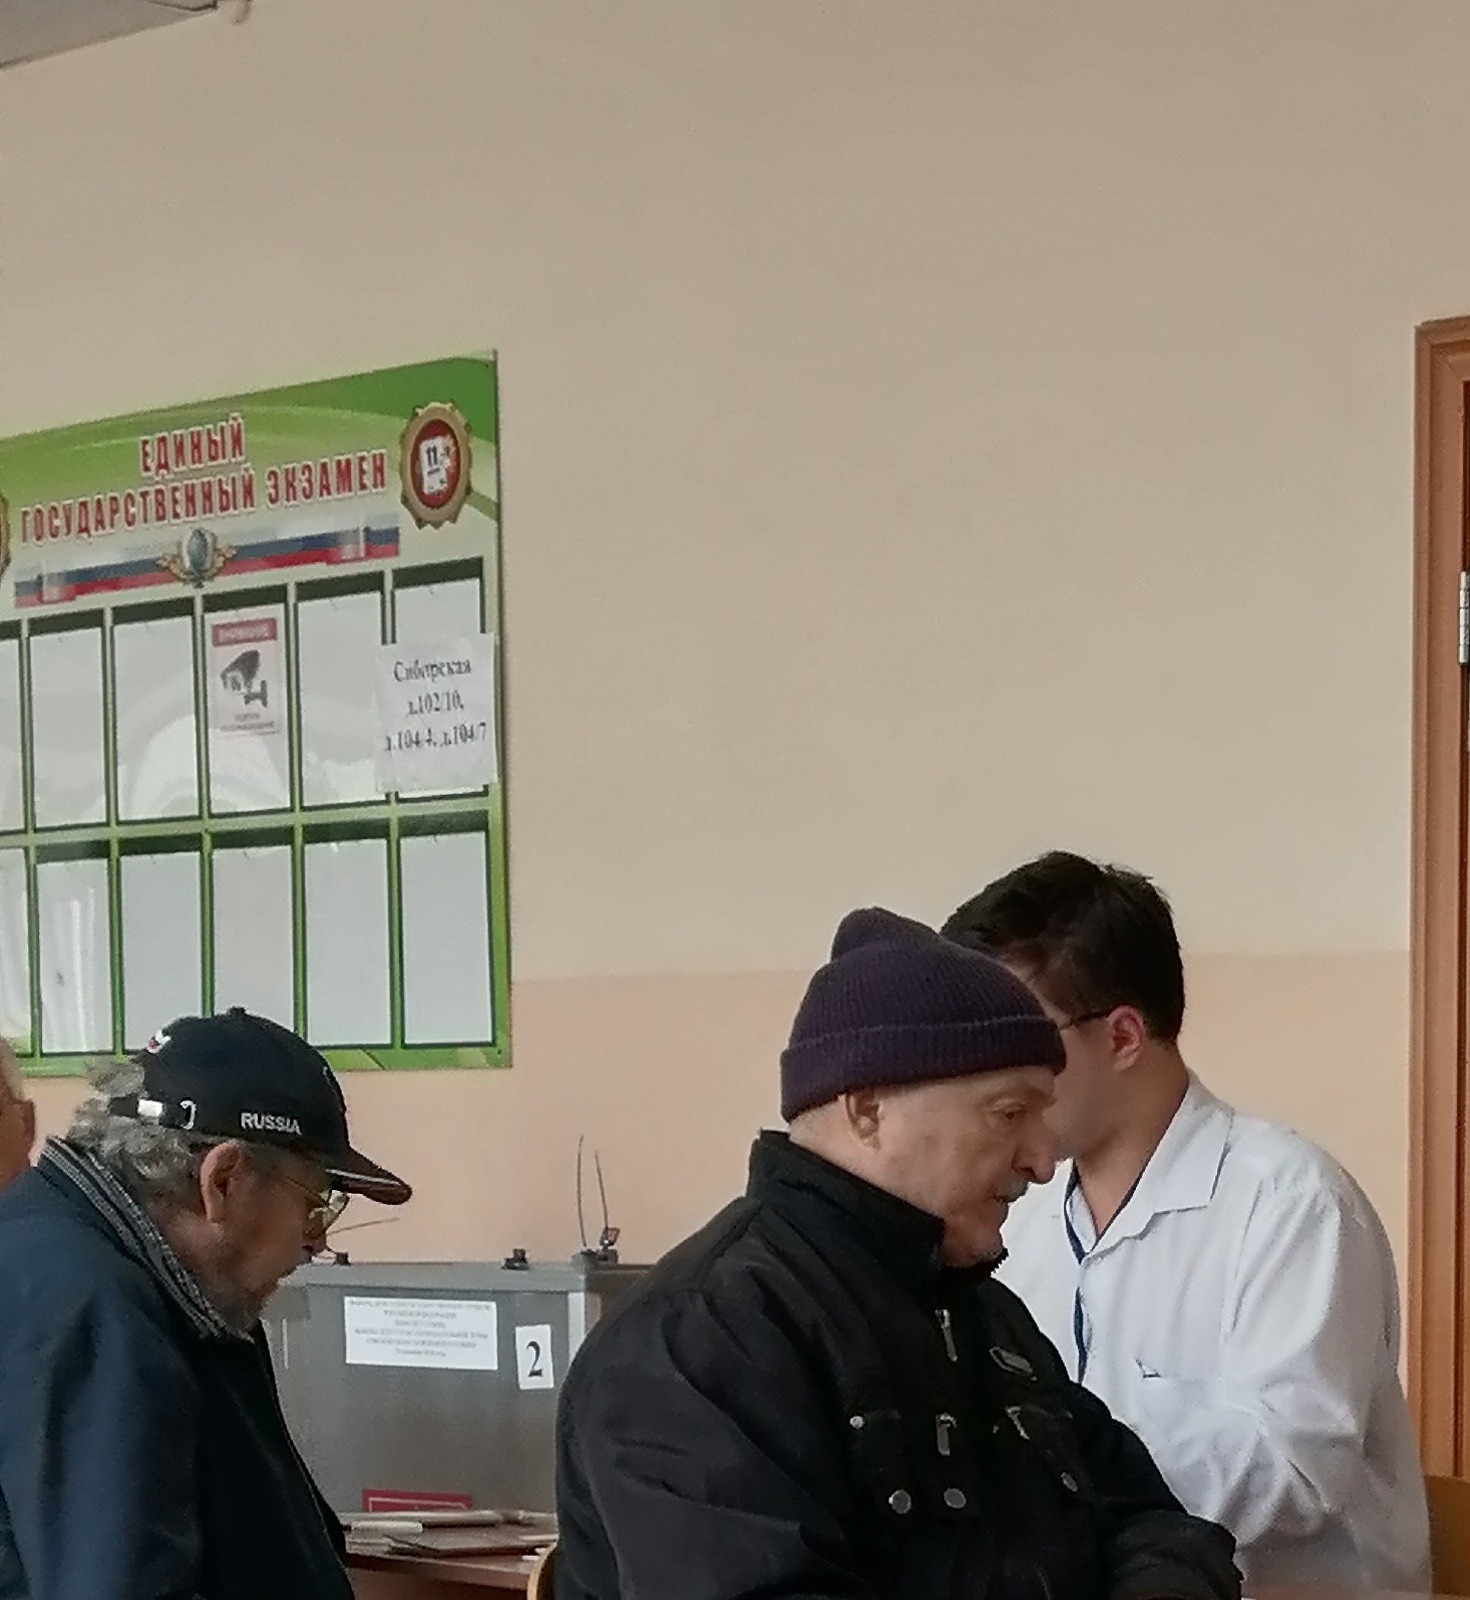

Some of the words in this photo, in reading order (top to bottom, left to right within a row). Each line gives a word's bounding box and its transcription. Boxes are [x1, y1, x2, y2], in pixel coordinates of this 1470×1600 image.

[140, 414, 244, 478] ЕДИНЫЙ
[20, 465, 255, 545] ГОСУДАРСТВЕННЫЙ
[266, 450, 386, 506] ЭКЗАМЕН
[240, 1111, 302, 1136] RUSSIA
[525, 1340, 545, 1378] 2
